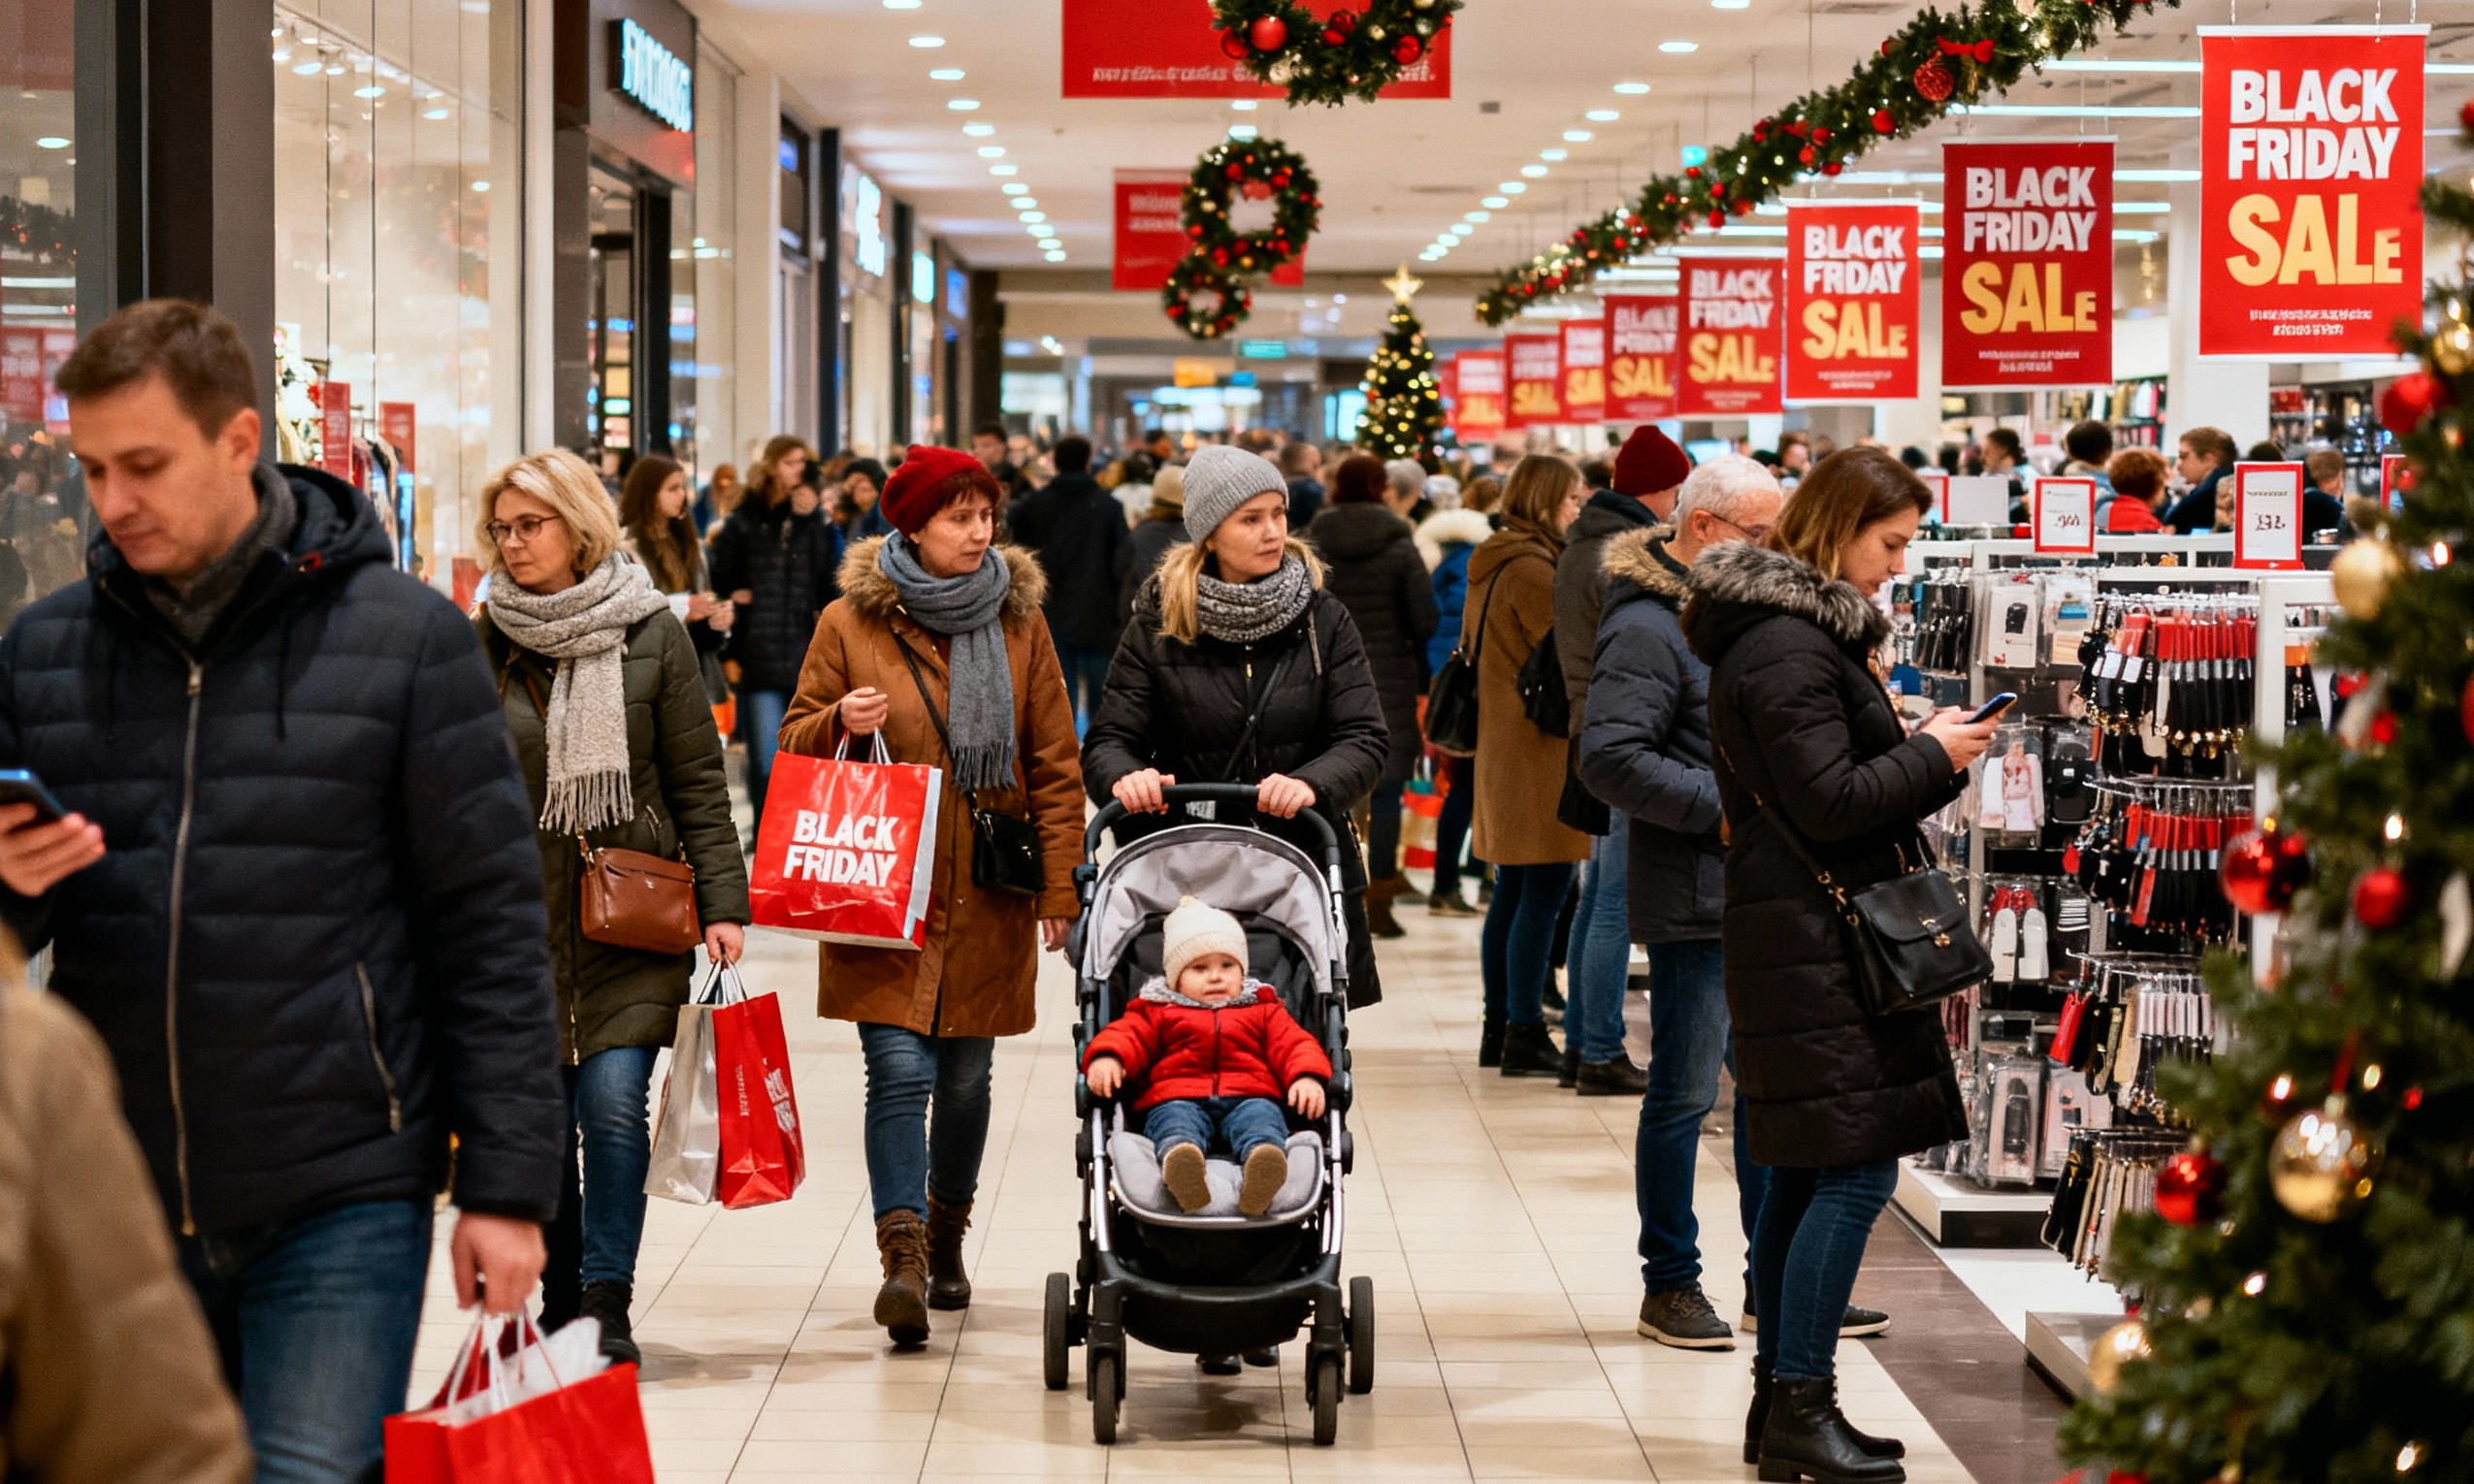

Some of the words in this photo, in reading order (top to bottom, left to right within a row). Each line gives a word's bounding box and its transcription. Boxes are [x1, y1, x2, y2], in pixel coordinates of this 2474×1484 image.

[2230, 67, 2399, 123] BLACK
[2228, 126, 2400, 180] FRIDAY
[1966, 167, 2097, 209] BLACK
[1804, 224, 1906, 259] BLACK
[1963, 210, 2098, 252] FRIDAY
[2226, 193, 2403, 287] SALE
[1689, 268, 1774, 299] BLACK
[1960, 260, 2098, 335] SALE
[1801, 300, 1908, 361] SALE
[1610, 356, 1676, 398] SAL
[1687, 333, 1775, 384] SALE
[793, 809, 899, 852] BLACK
[782, 845, 898, 888] FRIDAY
